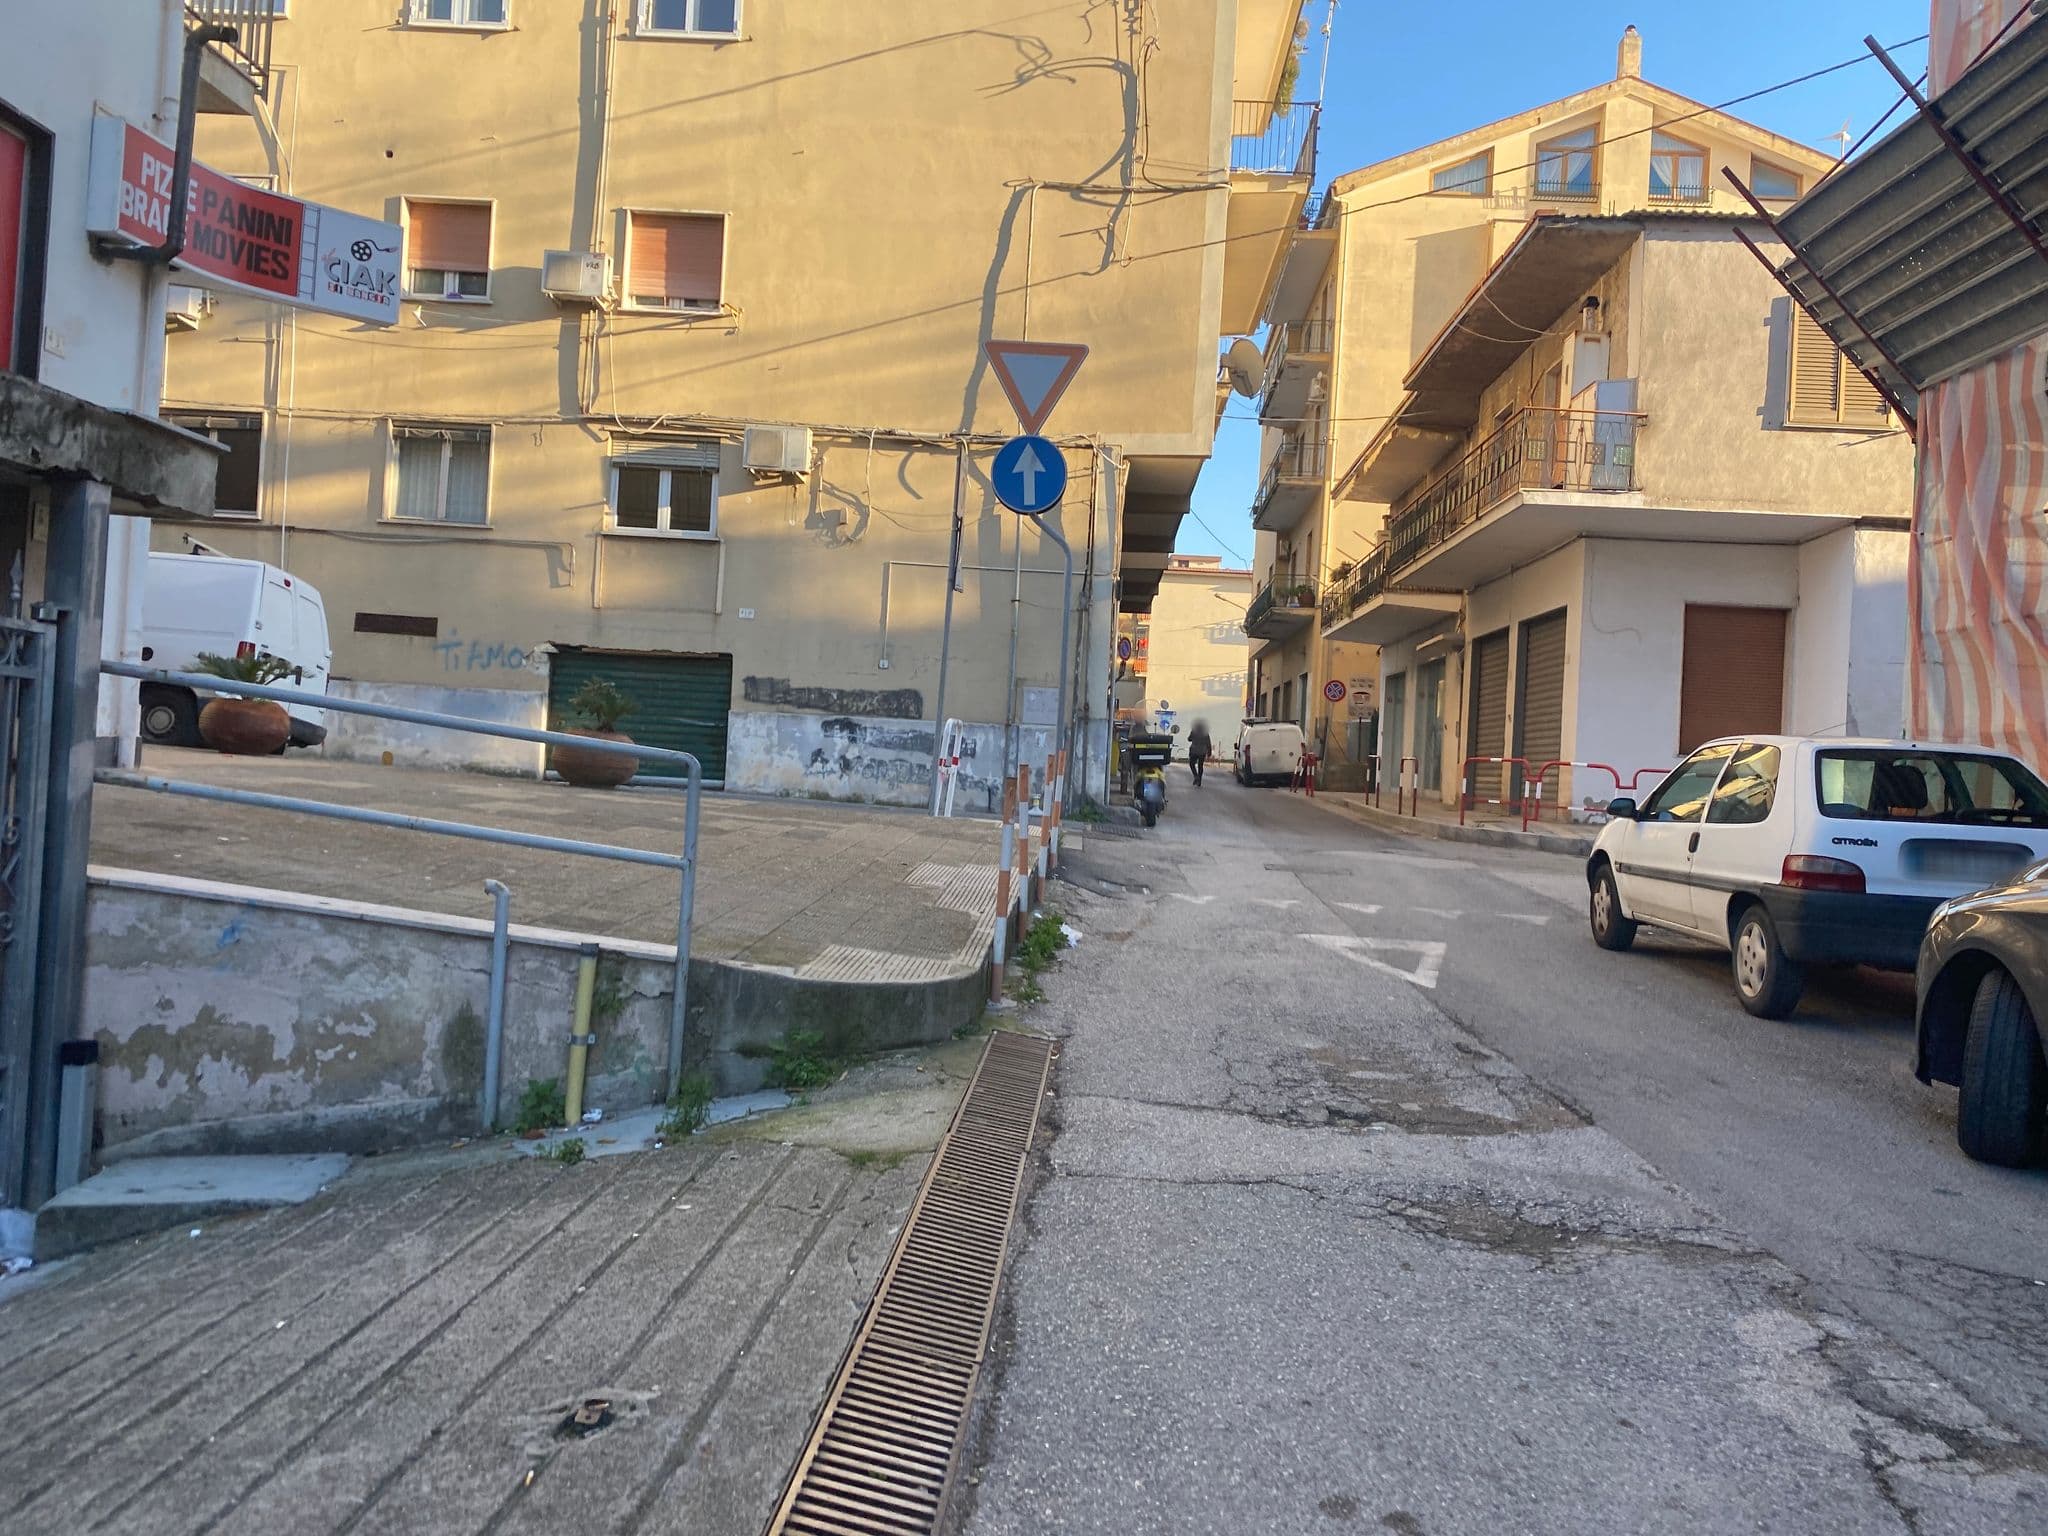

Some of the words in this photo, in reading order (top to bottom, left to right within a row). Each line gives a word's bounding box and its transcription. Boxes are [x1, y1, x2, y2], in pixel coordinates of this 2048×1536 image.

[141, 152, 198, 212] PIZE
[202, 185, 293, 247] PANINI
[192, 218, 290, 281] MOVIES
[324, 256, 396, 296] CIAK
